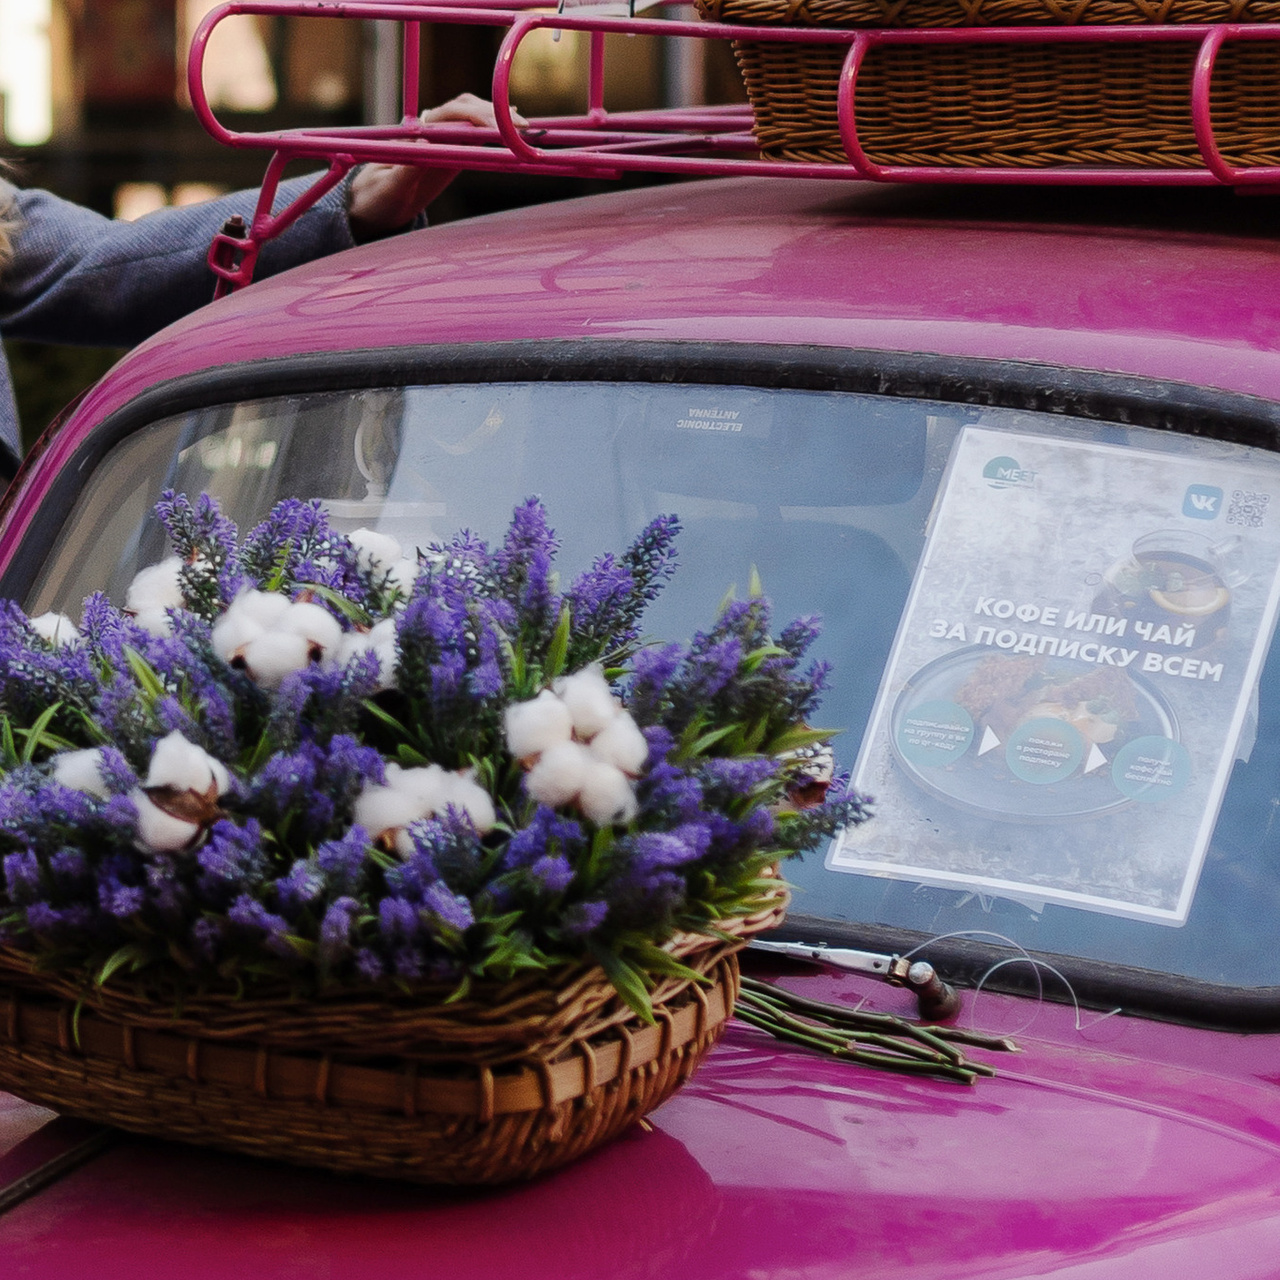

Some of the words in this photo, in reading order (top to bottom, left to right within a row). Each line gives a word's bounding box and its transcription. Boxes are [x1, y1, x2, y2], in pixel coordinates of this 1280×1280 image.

[688, 408, 740, 420] ANTENNA
[676, 419, 743, 432] ELECTRONIC
[996, 466, 1039, 483] MEET
[974, 596, 1060, 627] КОФЕ
[1064, 609, 1128, 637] ИЛИ
[1134, 622, 1197, 648] ЧАЙ
[929, 619, 967, 641] ЗА
[974, 625, 1139, 668] ПОДПИСКУ
[1142, 652, 1225, 682] ВСЕМ
